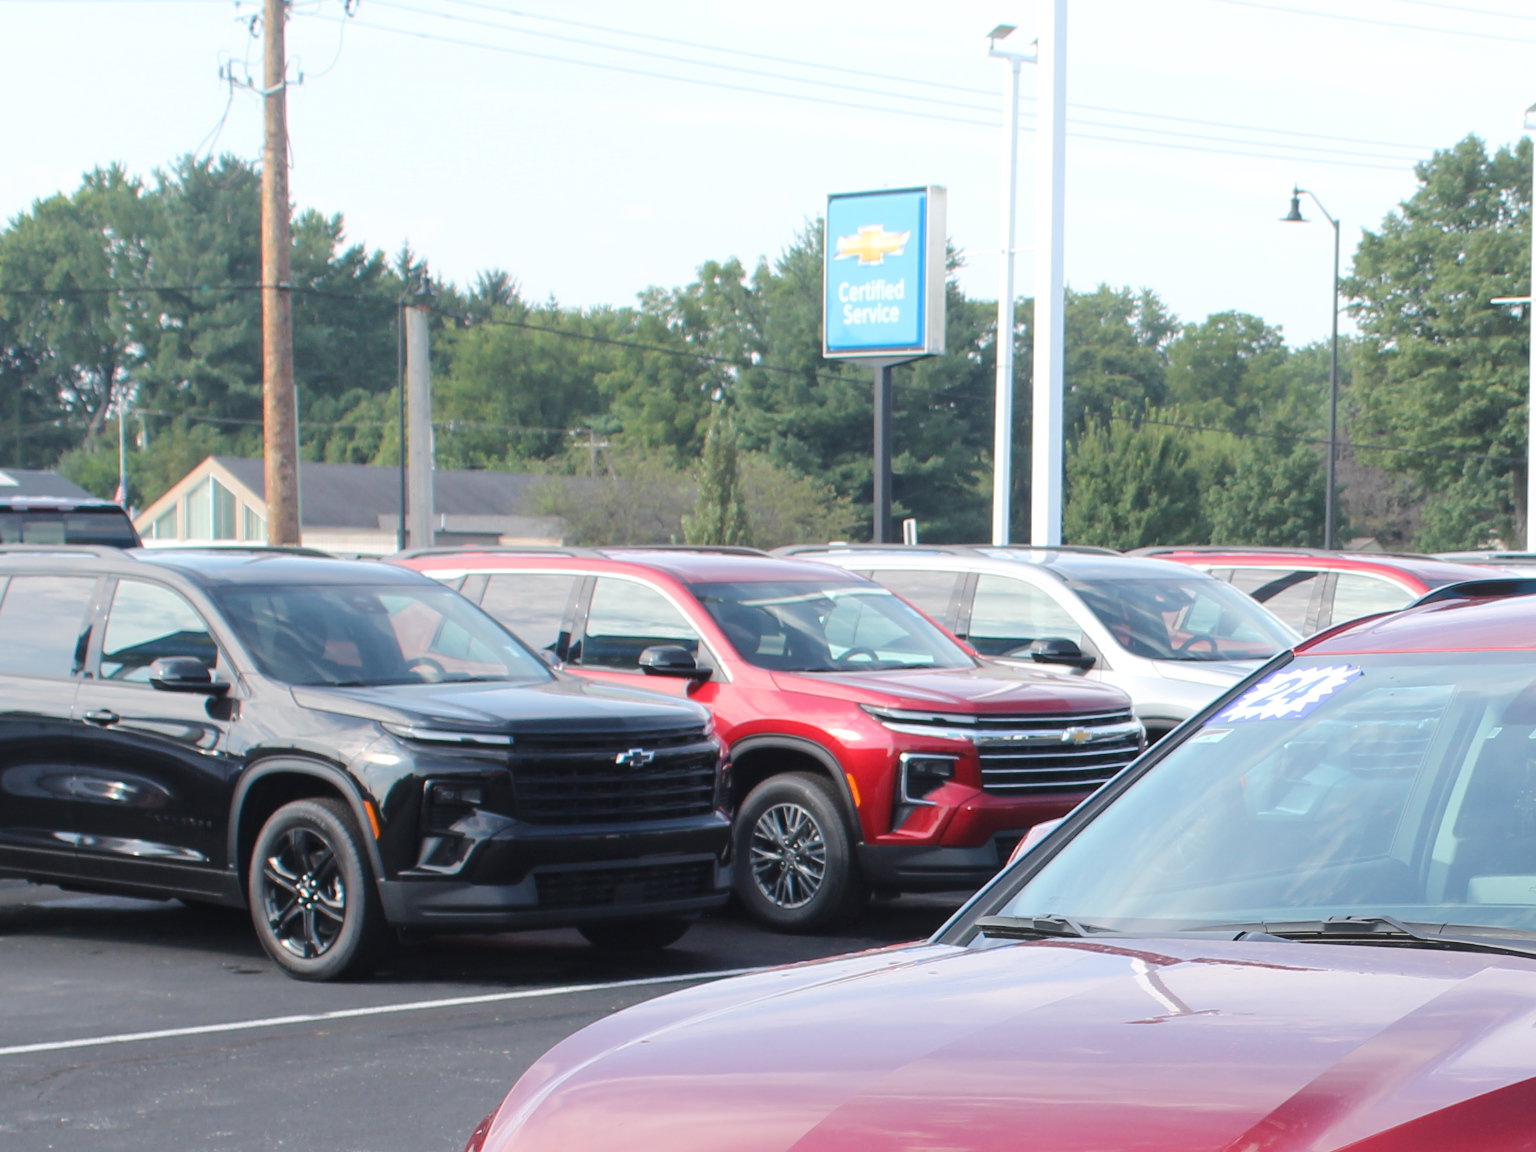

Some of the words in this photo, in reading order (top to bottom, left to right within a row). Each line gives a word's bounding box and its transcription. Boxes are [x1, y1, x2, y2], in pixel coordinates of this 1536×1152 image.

[838, 278, 905, 302] Certified
[843, 303, 899, 325] Service
[1246, 674, 1330, 708] 24
